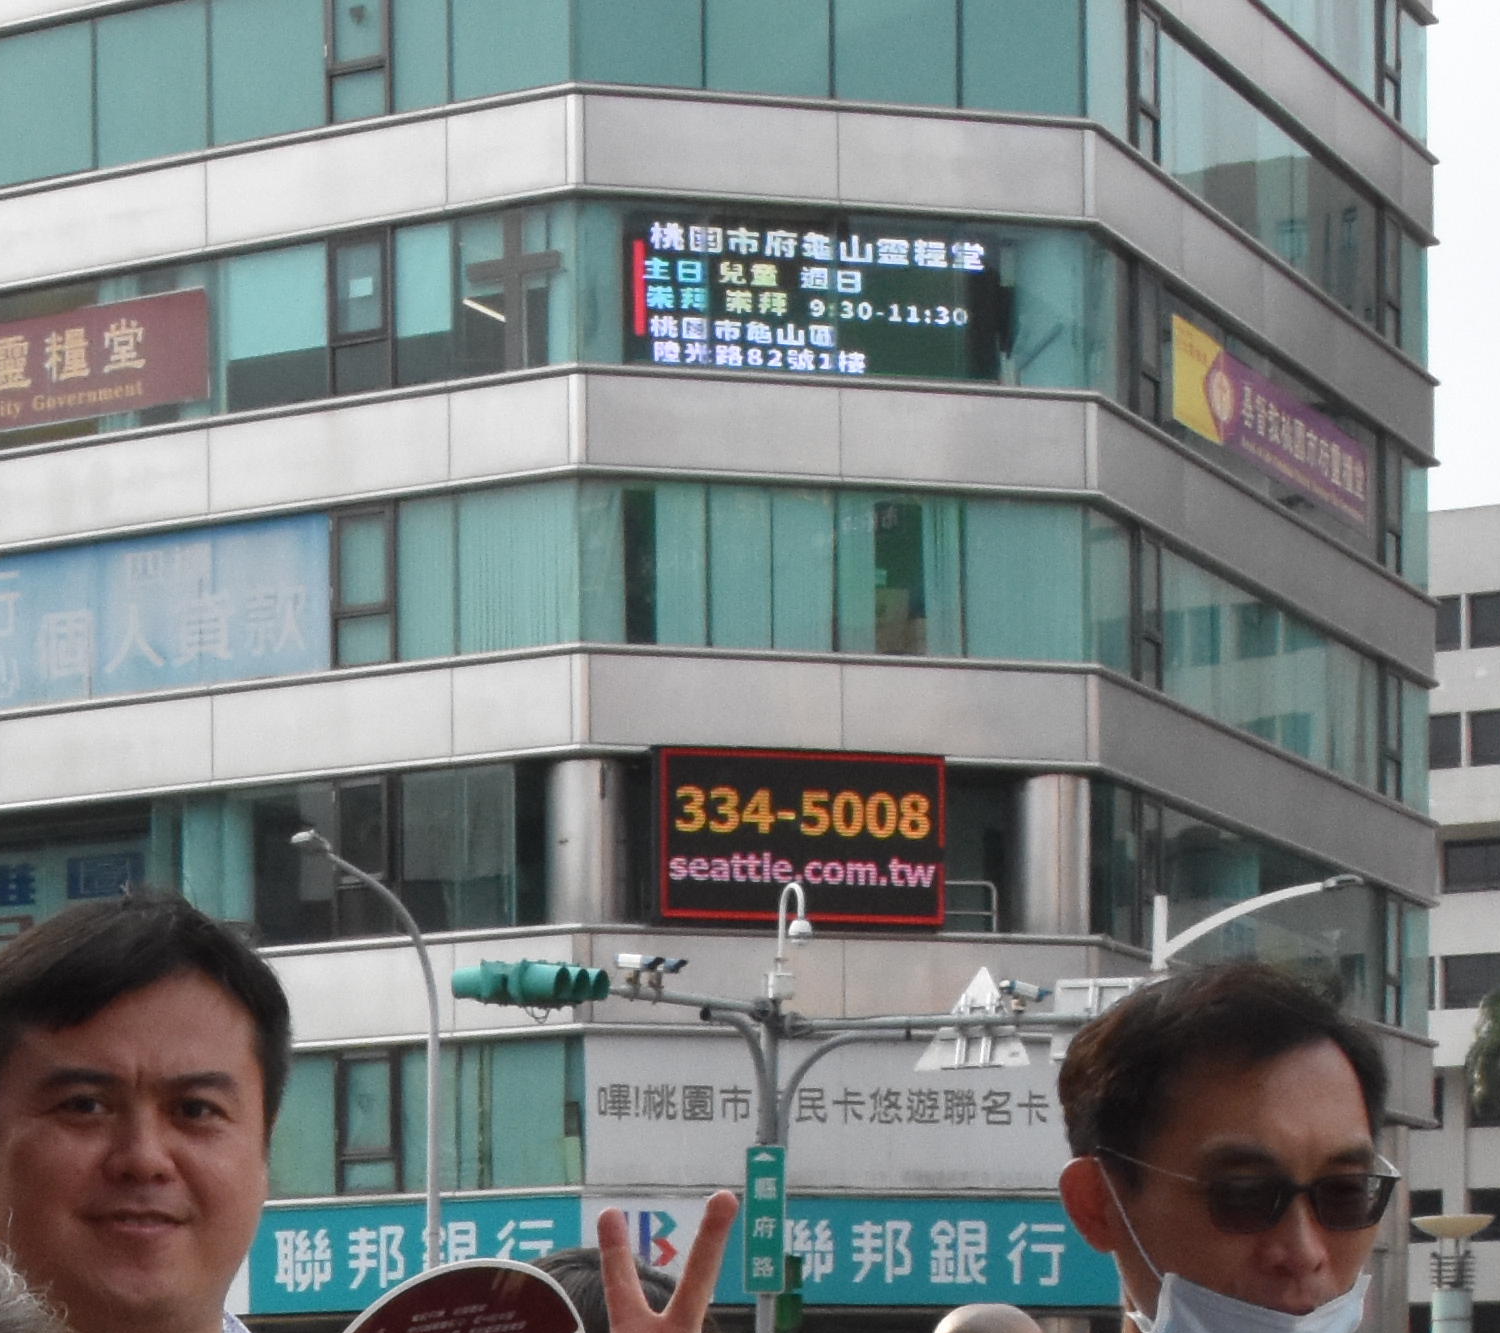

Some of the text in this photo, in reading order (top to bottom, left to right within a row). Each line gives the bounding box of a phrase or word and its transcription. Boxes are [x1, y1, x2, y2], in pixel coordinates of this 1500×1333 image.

[643, 257, 703, 283] 主日
[33, 379, 144, 415] Government
[674, 785, 932, 840] 334-5008
[668, 850, 937, 889] seattle.com.tw
[598, 1084, 1049, 1127] 嗶!桃園市民卡悠遊聯名卡
[751, 1177, 778, 1280] 縣府路
[783, 1218, 1067, 1287] 聯邦銀行
